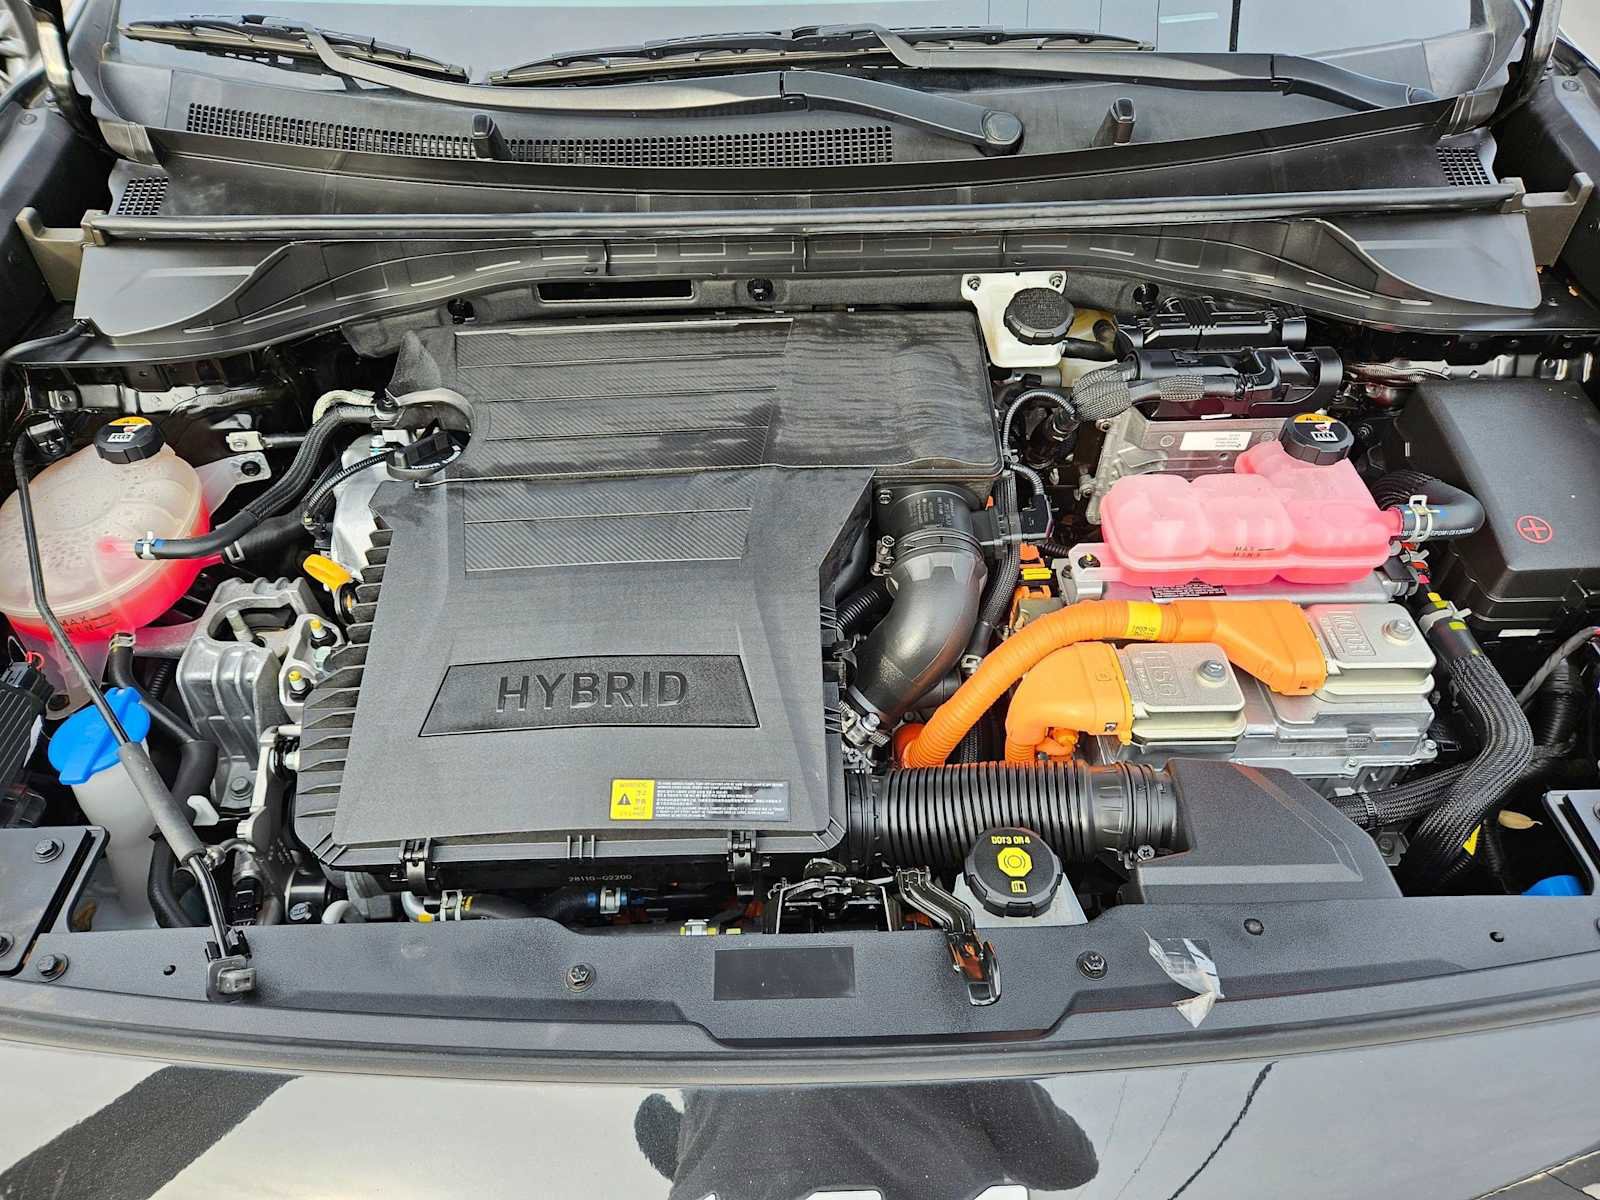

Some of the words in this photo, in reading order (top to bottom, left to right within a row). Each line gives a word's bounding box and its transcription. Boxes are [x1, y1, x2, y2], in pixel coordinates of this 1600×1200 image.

[60, 616, 89, 626] MAX
[1332, 615, 1371, 655] MOTOR
[496, 671, 688, 713] HYBRID
[991, 835, 1012, 844] DOT3
[1013, 835, 1024, 844] OR
[1025, 835, 1031, 844] 4
